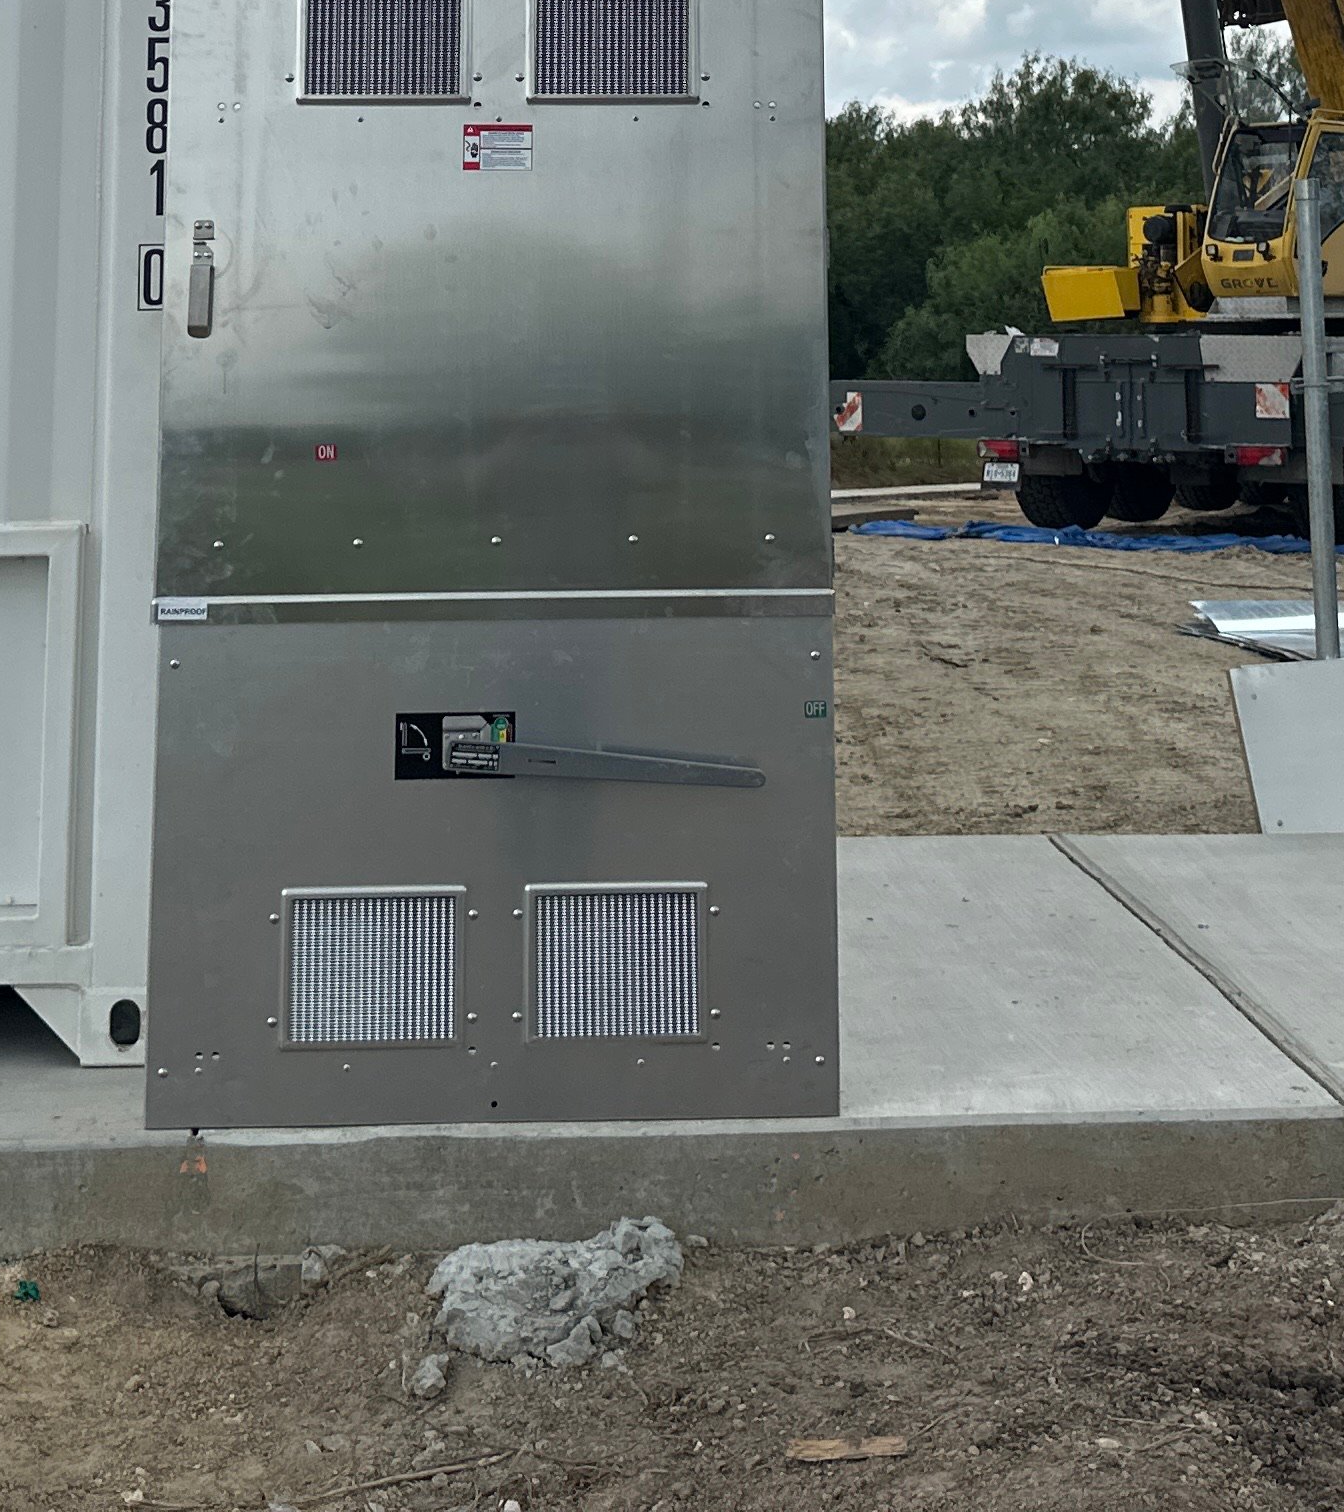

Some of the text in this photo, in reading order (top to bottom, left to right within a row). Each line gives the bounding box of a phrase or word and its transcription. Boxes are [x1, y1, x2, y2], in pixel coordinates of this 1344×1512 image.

[143, 248, 165, 306] 0
[317, 444, 335, 459] ON
[160, 607, 206, 616] RAINPROOF
[805, 701, 825, 716] OFF
